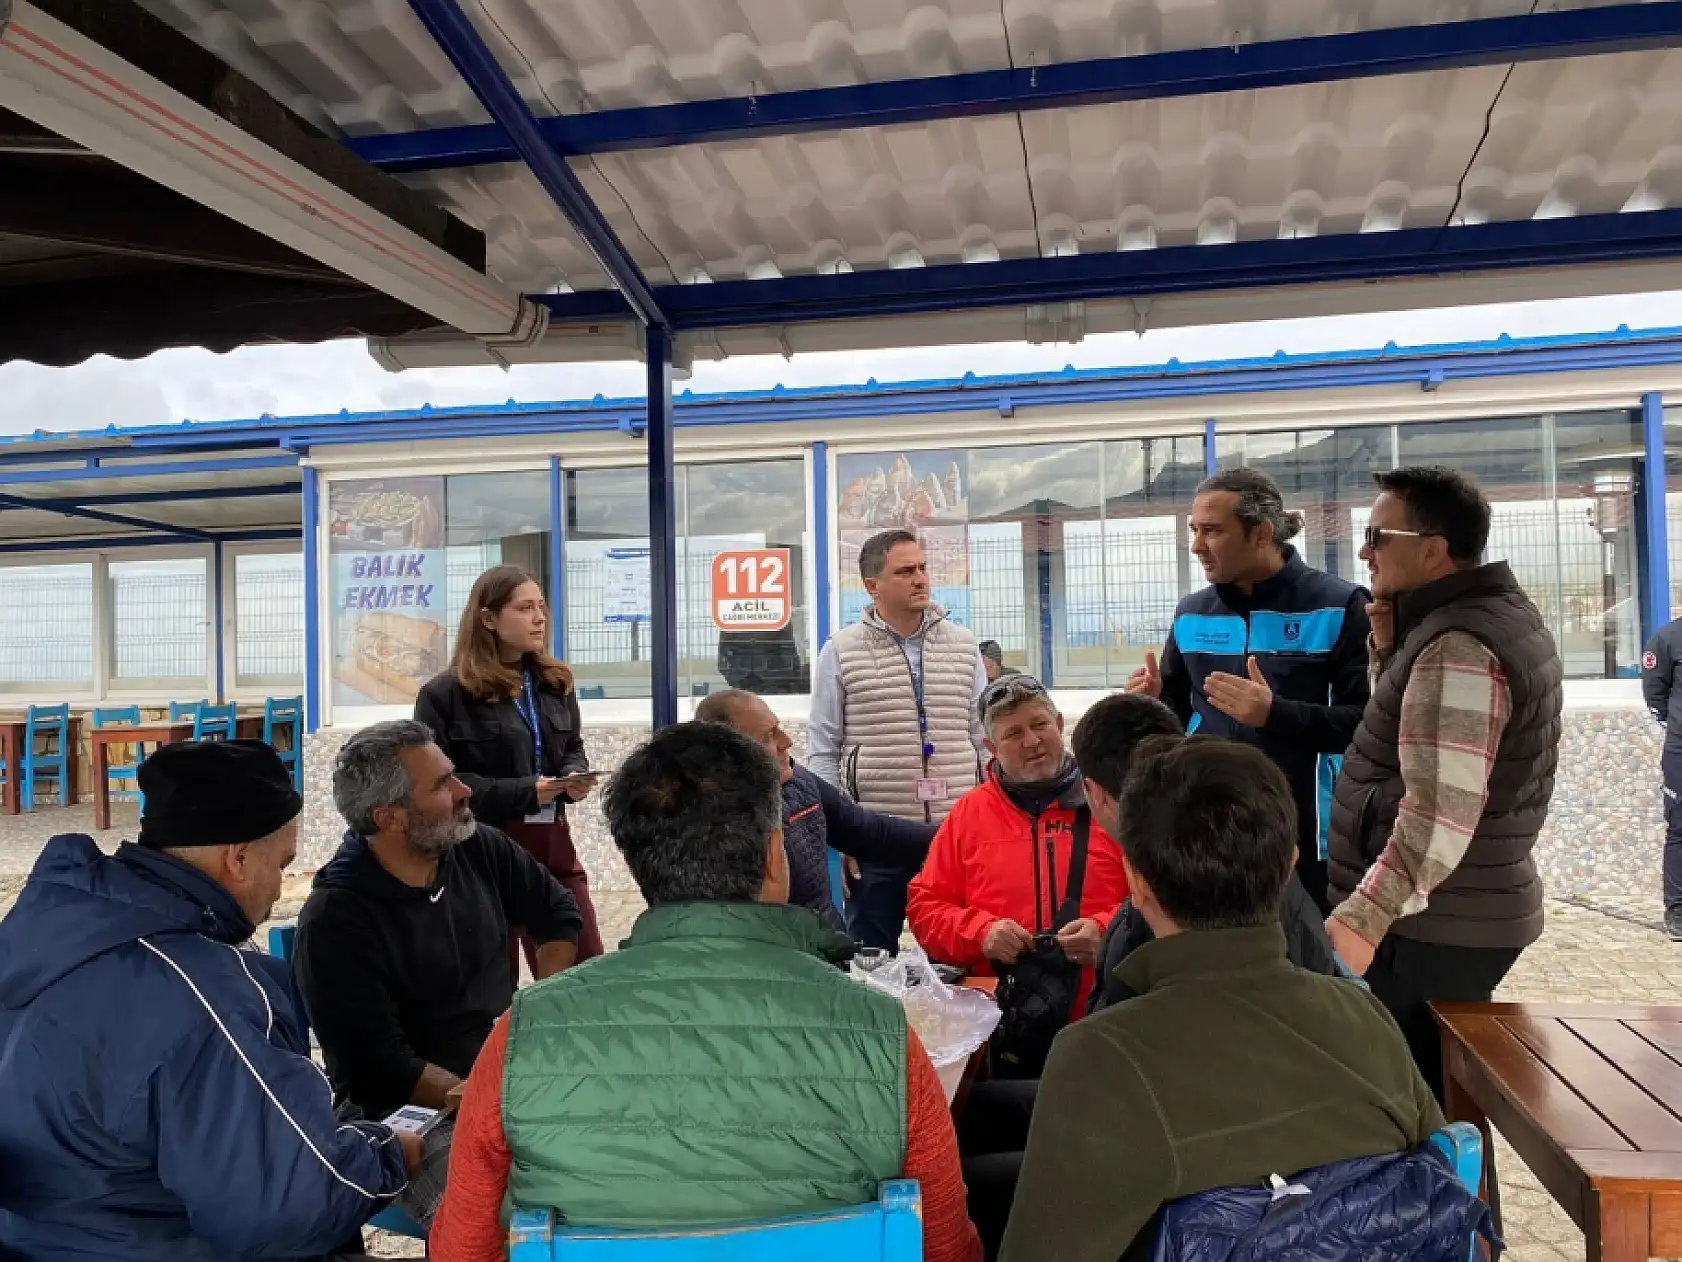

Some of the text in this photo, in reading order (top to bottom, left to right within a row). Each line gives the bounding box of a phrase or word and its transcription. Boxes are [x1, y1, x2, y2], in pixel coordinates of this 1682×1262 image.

[350, 553, 425, 578] BALIK
[719, 556, 784, 593] 112
[344, 584, 434, 609] EKMEK
